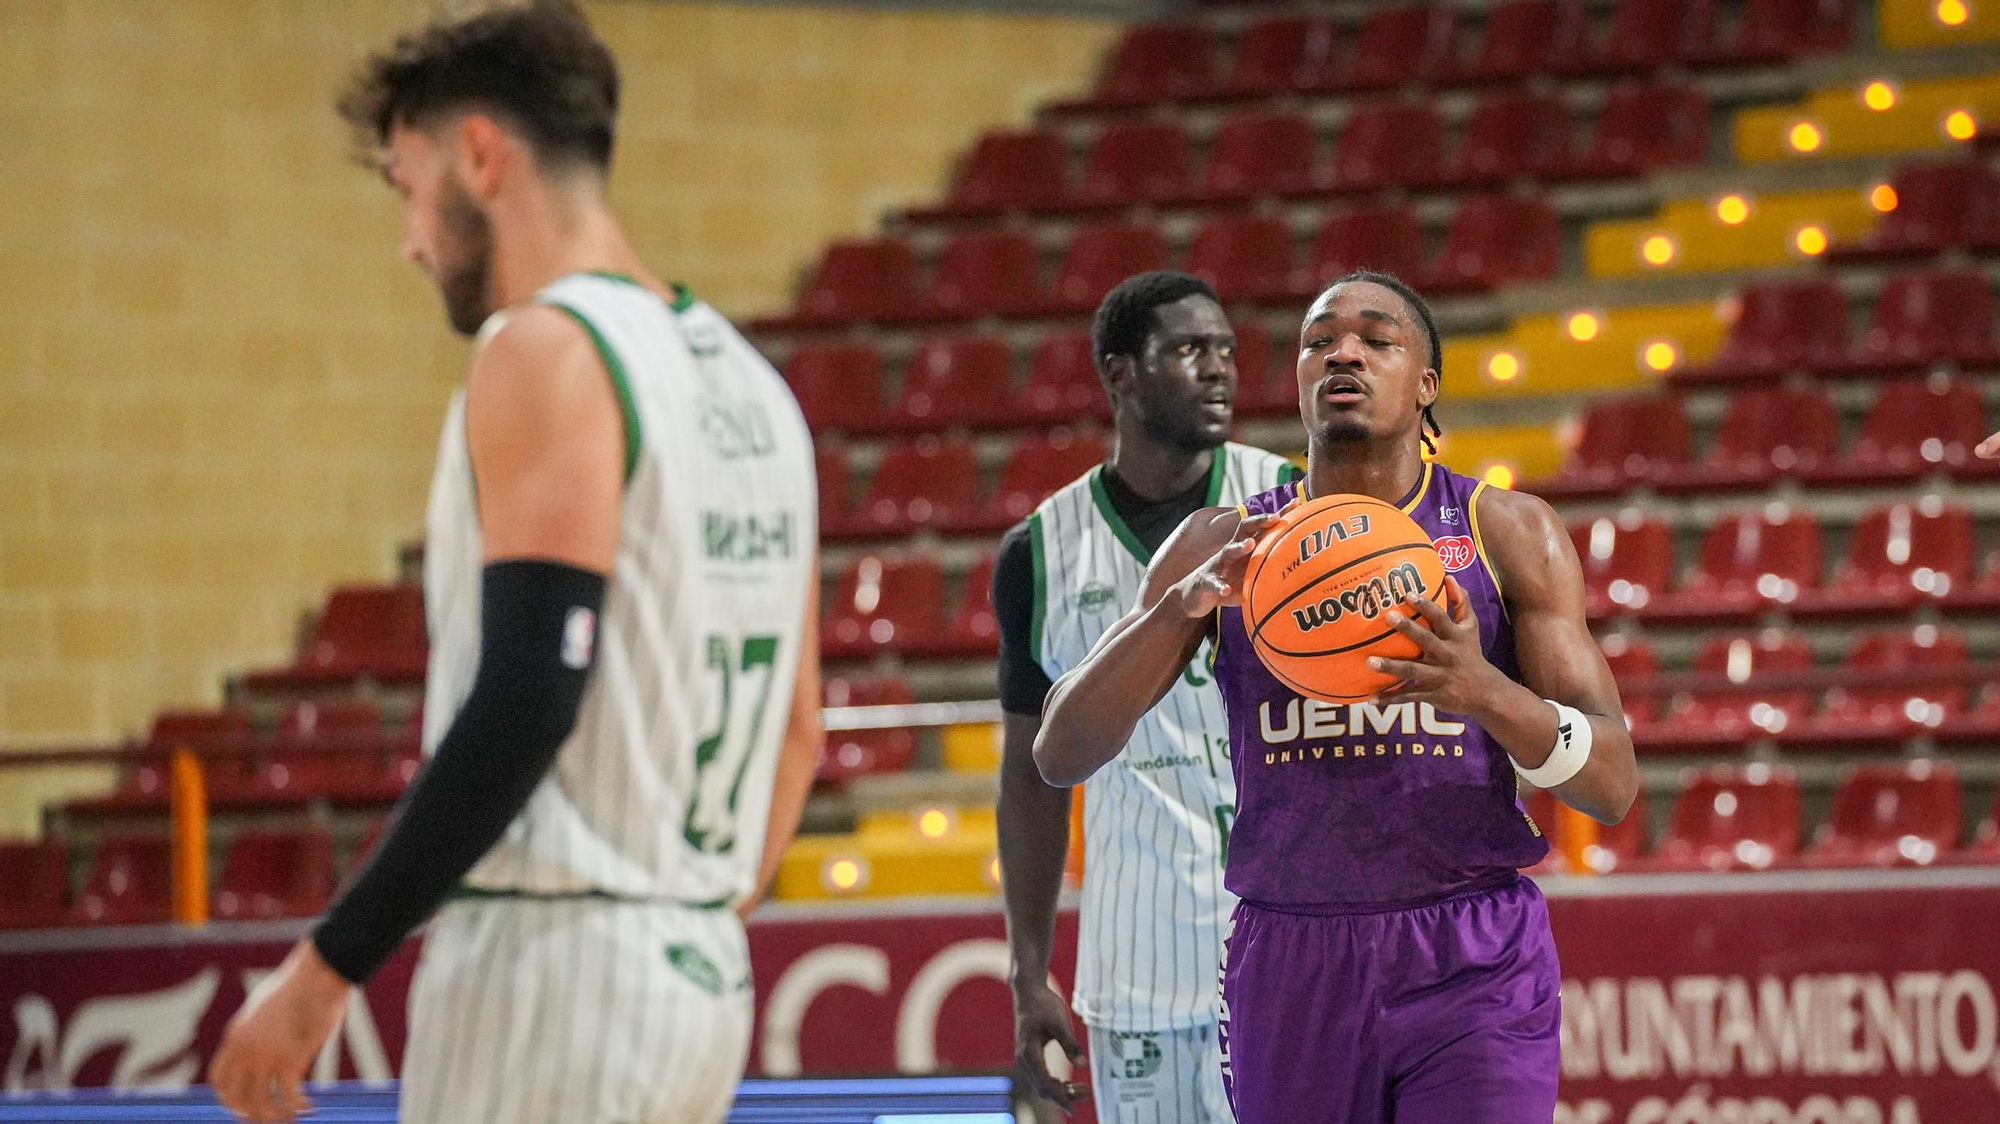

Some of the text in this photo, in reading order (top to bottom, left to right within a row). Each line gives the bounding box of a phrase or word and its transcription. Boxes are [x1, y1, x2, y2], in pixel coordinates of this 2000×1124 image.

[1281, 557, 1300, 582] NXT
[1291, 561, 1427, 632] Wilson
[1265, 743, 1465, 765] UNIVERSIDAD
[1522, 812, 1542, 837] UTURO
